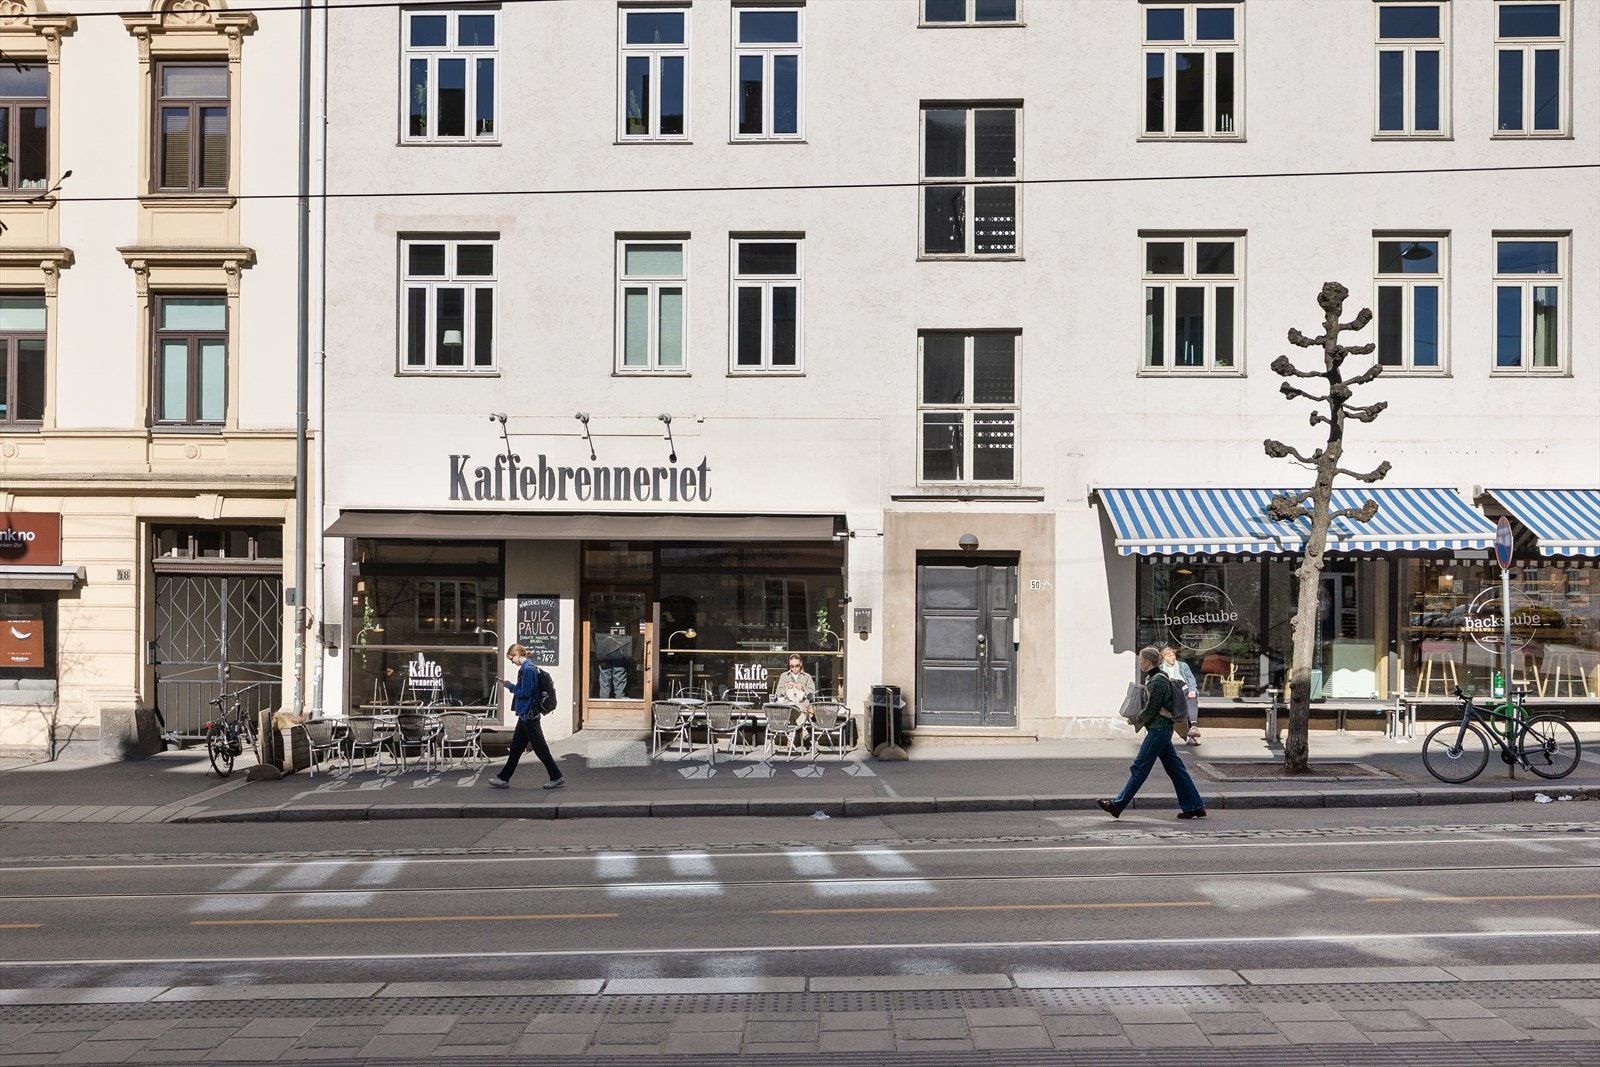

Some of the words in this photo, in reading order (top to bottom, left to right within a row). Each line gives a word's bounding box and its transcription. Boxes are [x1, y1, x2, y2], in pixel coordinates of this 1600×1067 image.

[448, 454, 712, 501] Kaffebrenneriet
[117, 570, 129, 580] 48
[1031, 580, 1040, 589] 50
[524, 610, 550, 622] LUIZ
[1163, 610, 1238, 626] backstube
[1465, 612, 1540, 629] backsube
[519, 622, 554, 635] PAULO
[409, 660, 442, 678] Kaffe
[734, 663, 768, 681] Kaffe
[409, 677, 442, 687] brenneriet
[734, 680, 768, 690] brenneriet
